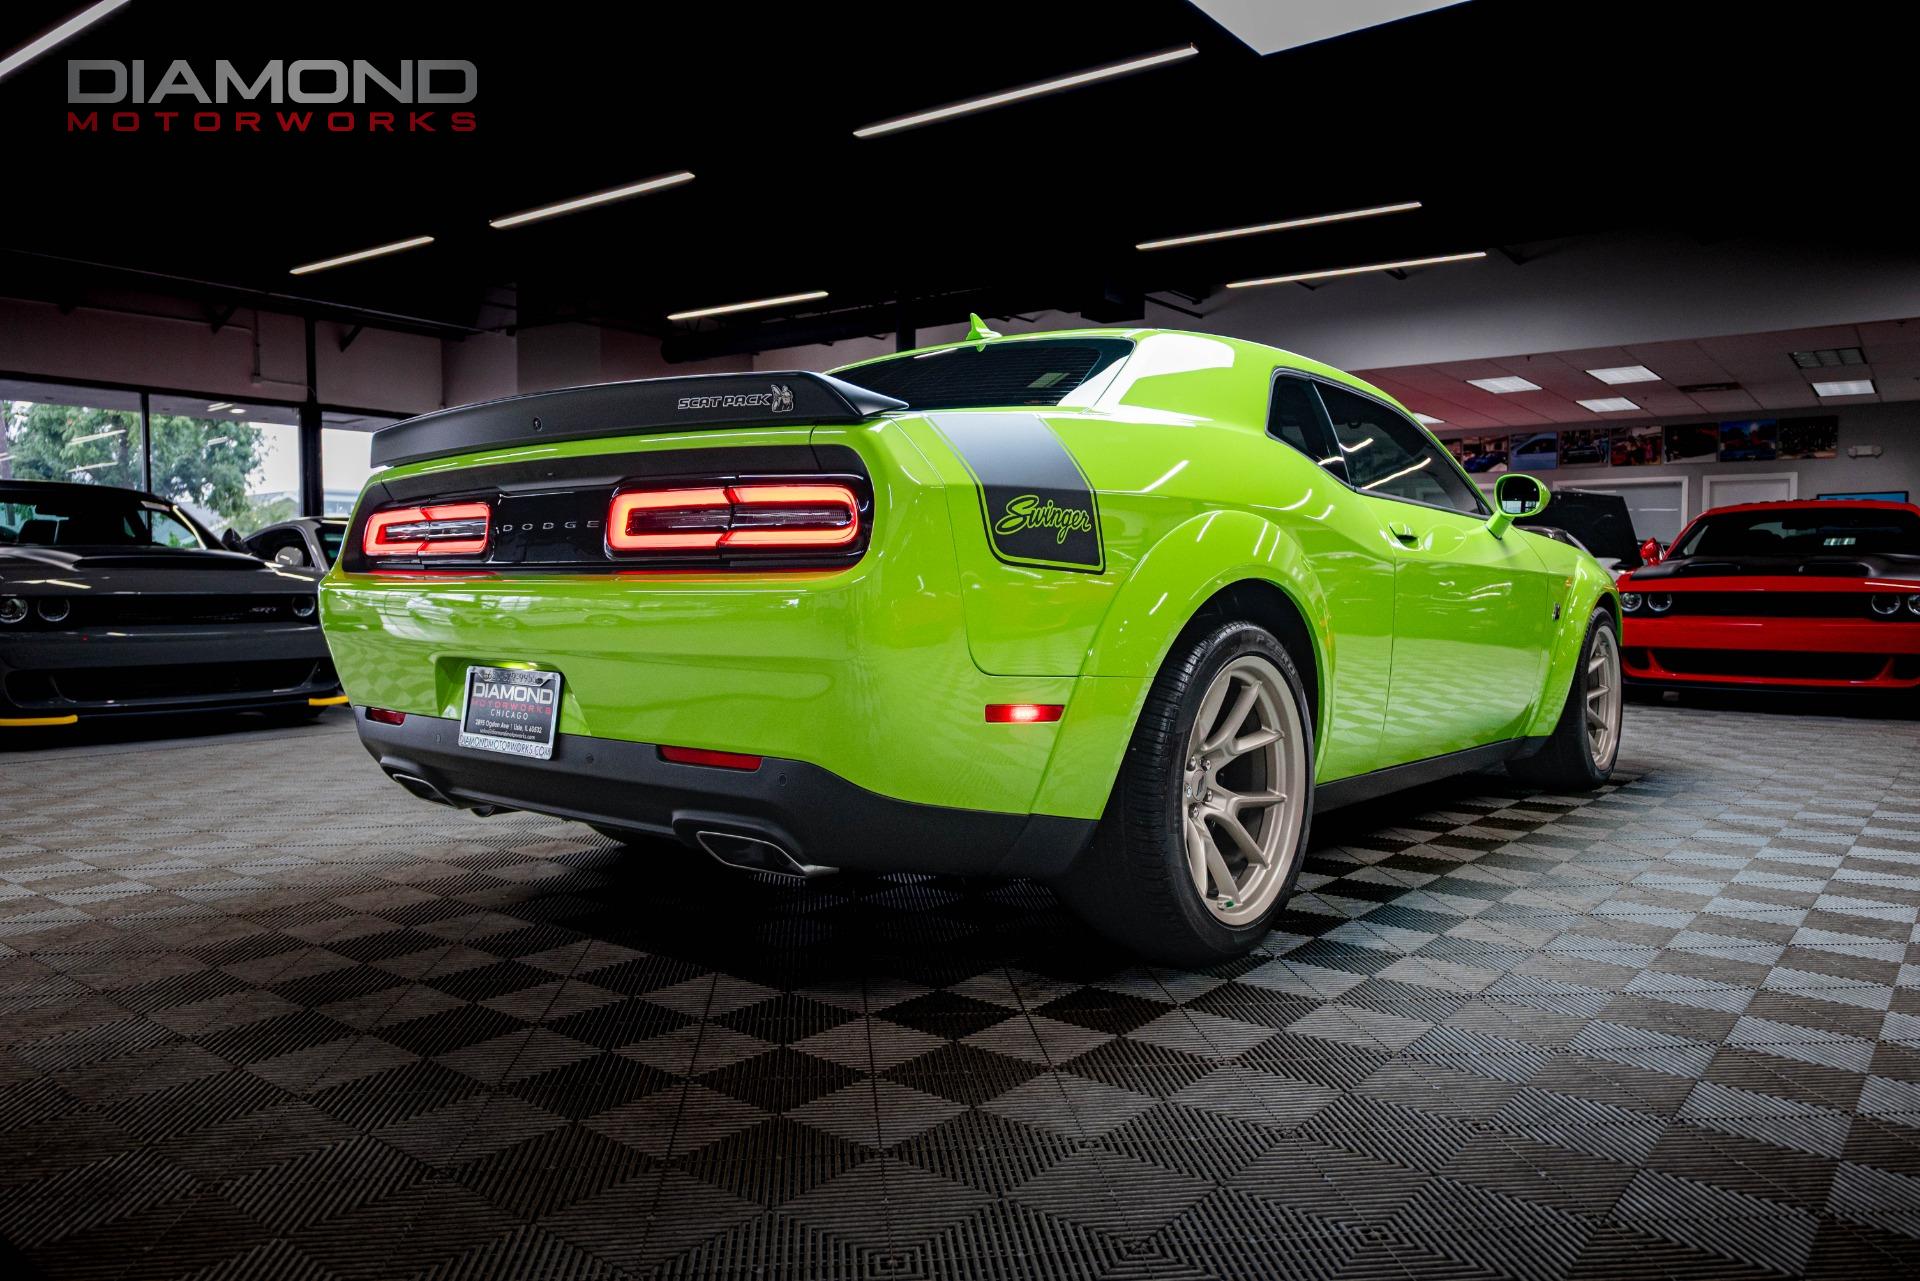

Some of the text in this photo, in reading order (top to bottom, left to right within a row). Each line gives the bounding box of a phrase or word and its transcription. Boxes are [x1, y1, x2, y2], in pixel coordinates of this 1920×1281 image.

[678, 394, 772, 409] SCAT PACK
[502, 520, 599, 532] DODGE
[995, 494, 1091, 544] Swinger
[473, 683, 553, 704] DIAMOND
[471, 699, 552, 715] MOTORWORKS
[491, 709, 528, 720] CHICAGO
